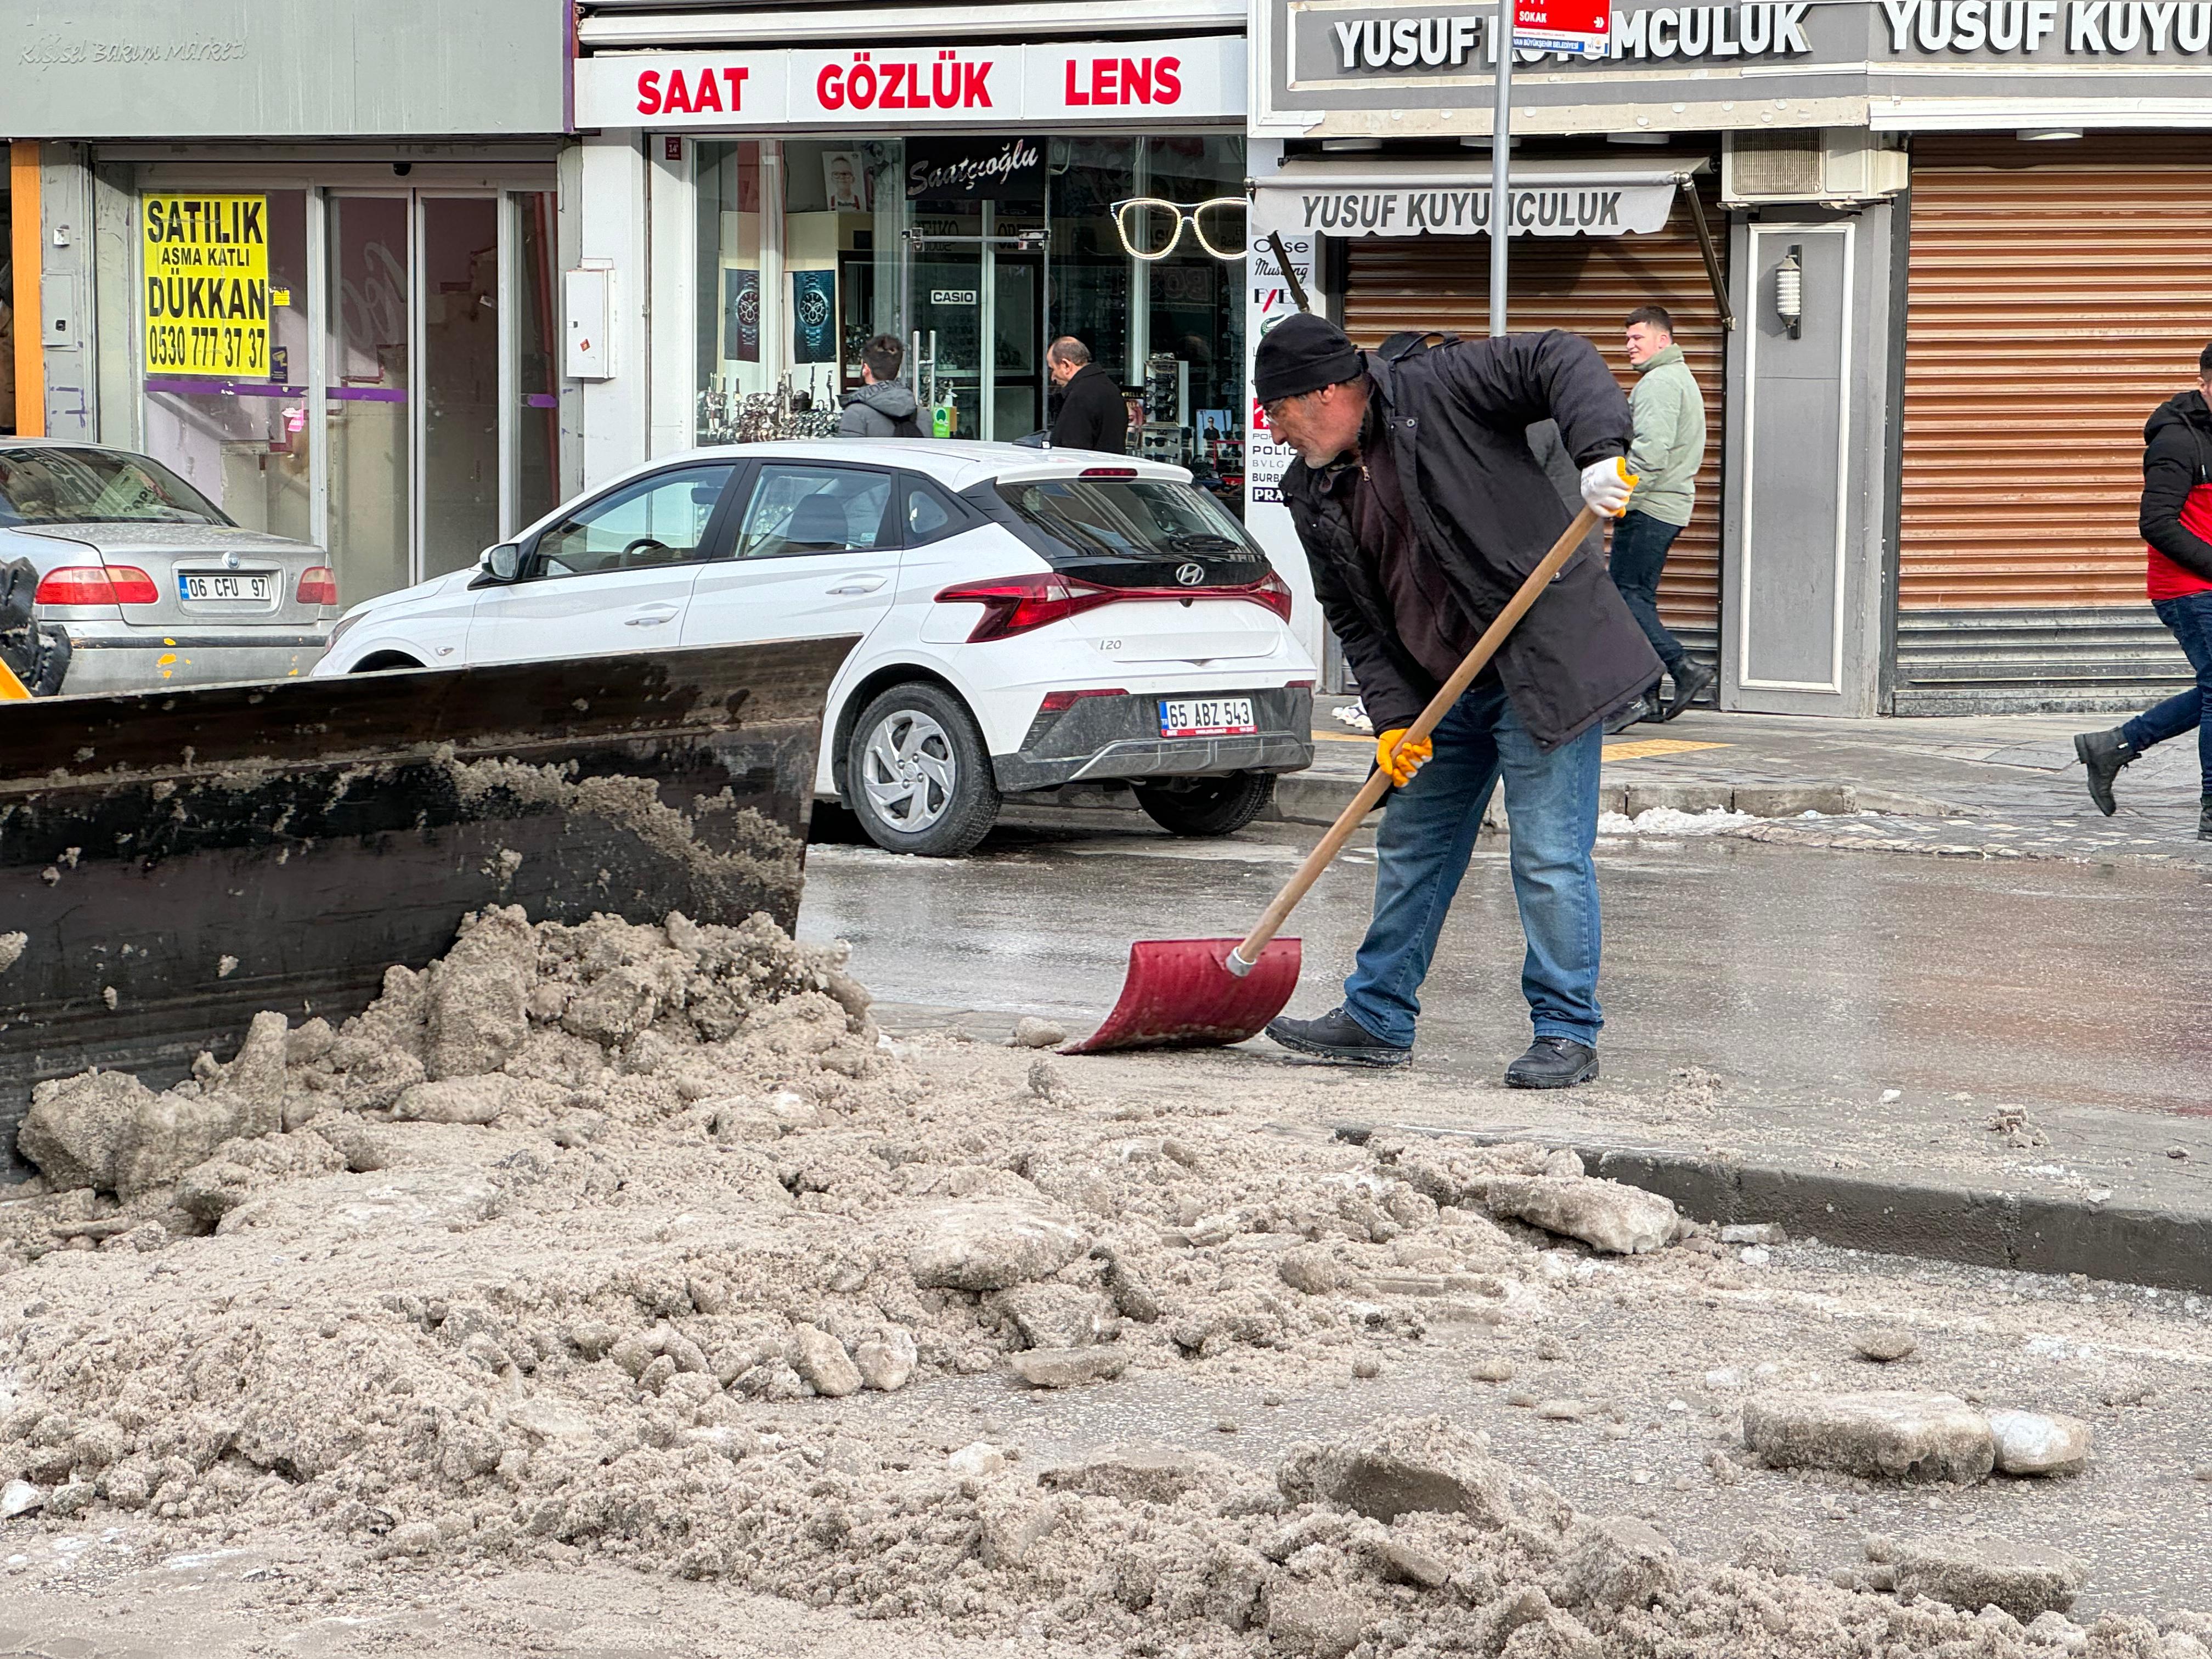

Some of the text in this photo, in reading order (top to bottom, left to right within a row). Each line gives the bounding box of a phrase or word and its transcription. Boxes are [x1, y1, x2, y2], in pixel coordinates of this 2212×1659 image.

[1519, 10, 1547, 23] SOKAK
[1884, 0, 2057, 51] YUSUF
[1334, 3, 1813, 67] YUSUF MCULUK
[636, 50, 1182, 116] SAAT GÖZLÜK LENS
[147, 200, 263, 244] SATILIK
[1302, 192, 1622, 227] YUSUF KUYUCULUK
[161, 247, 250, 267] ASMA KATLI
[1254, 239, 1309, 253] Ose
[1255, 257, 1310, 284] Musng
[148, 267, 266, 320] DÜKKAN
[933, 292, 974, 302] CASIO
[150, 325, 265, 368] 0530 777 37 37
[1252, 460, 1293, 468] BVLG
[1254, 489, 1284, 500] PRA
[189, 578, 207, 597] 06
[215, 578, 239, 597] CFU
[251, 579, 265, 597] 97
[1169, 704, 1188, 728] 65
[1195, 703, 1220, 727] ABZ
[1224, 702, 1250, 725] 543
